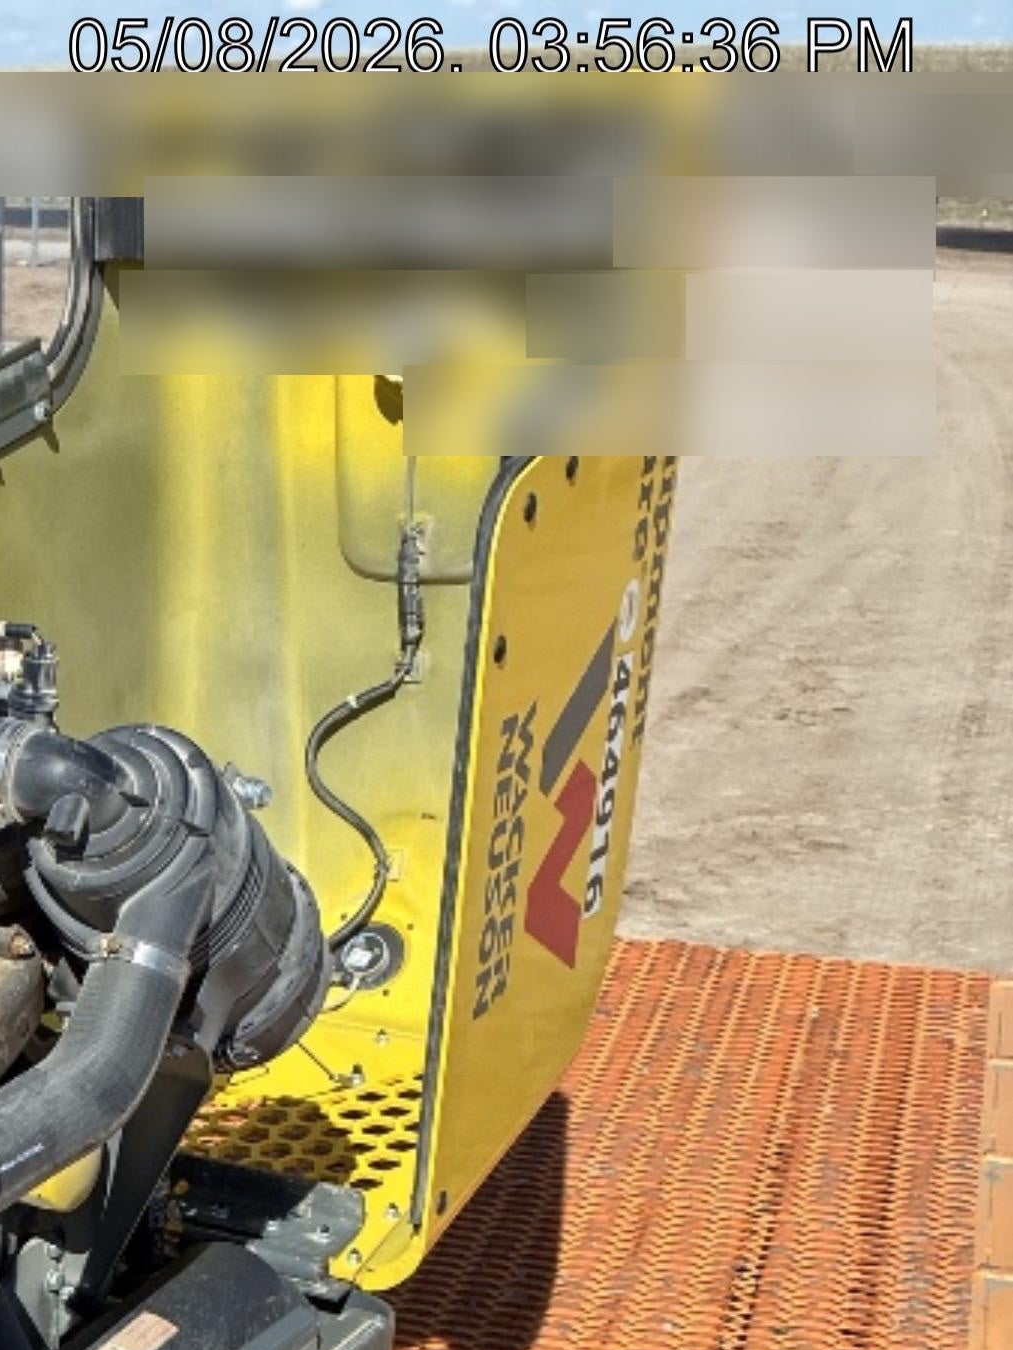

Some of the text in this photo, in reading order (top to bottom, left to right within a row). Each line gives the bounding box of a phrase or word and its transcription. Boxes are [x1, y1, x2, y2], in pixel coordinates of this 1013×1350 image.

[472, 713, 519, 1021] NEUSON
[491, 696, 539, 1004] WACKER
[584, 659, 630, 914] 464916
